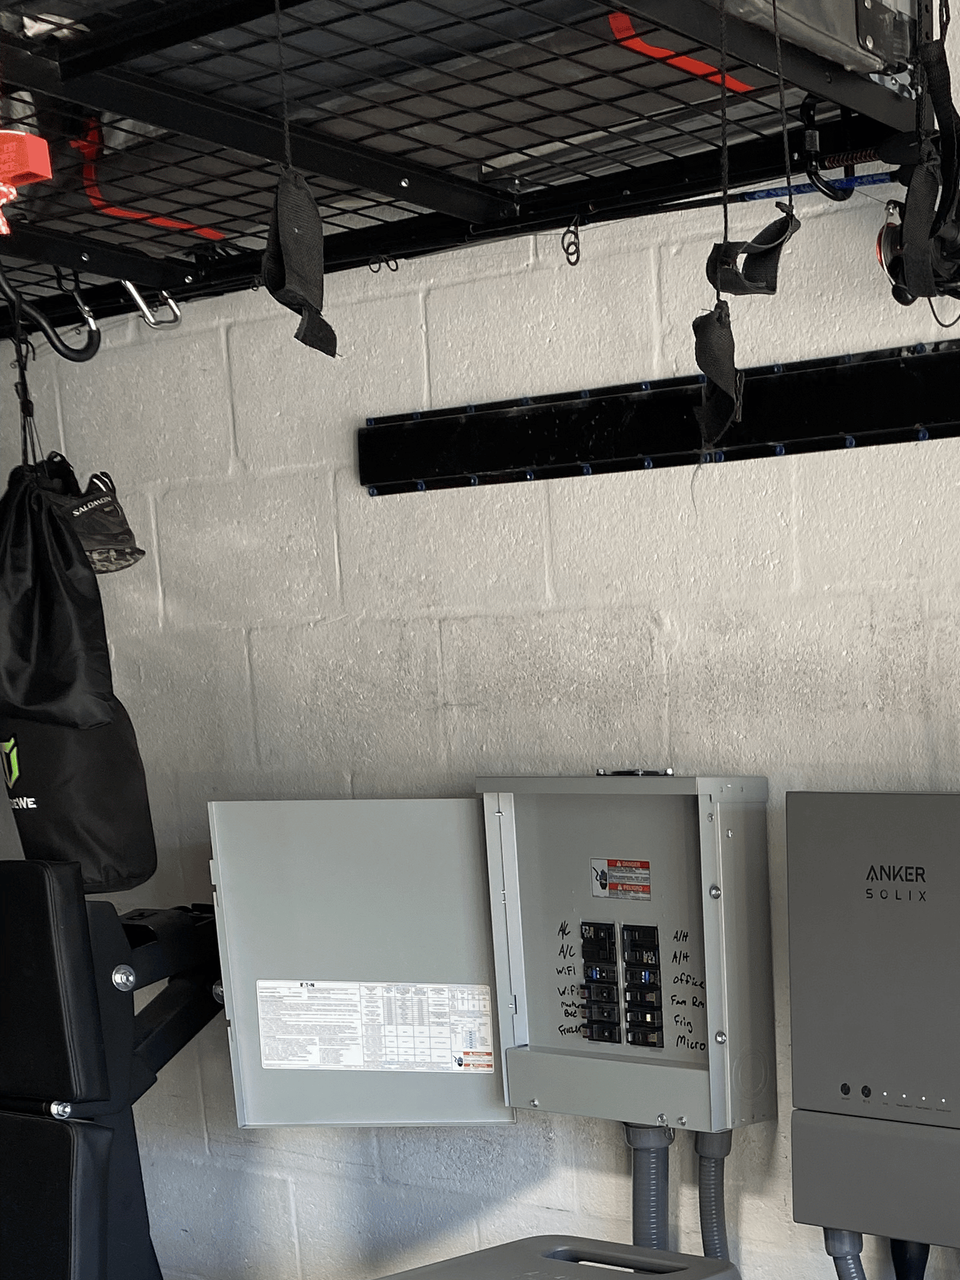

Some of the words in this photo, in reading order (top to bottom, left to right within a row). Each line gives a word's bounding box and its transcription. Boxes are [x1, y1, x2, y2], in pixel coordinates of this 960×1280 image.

[72, 496, 112, 517] SALOMON
[866, 865, 926, 883] ANKER
[866, 888, 926, 901] SOLIX
[558, 943, 576, 960] A/C
[672, 950, 690, 965] A/H
[676, 1035, 706, 1051] Micro
